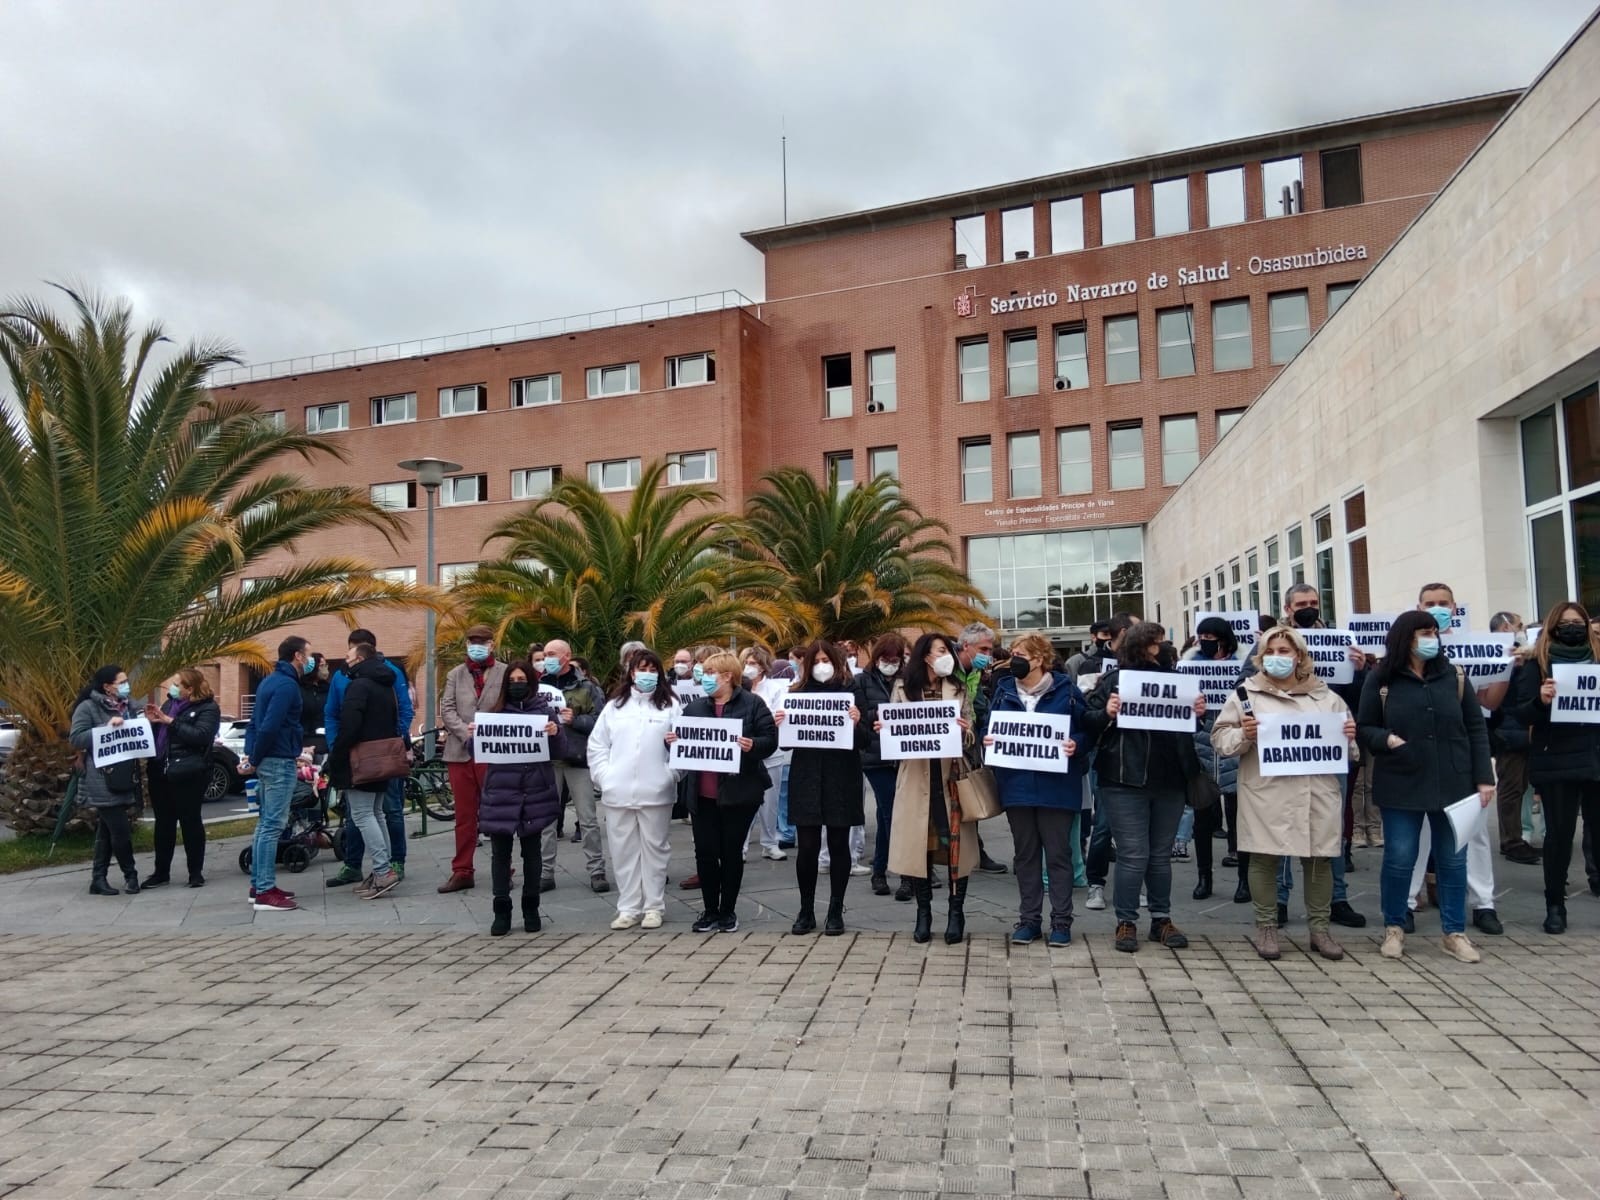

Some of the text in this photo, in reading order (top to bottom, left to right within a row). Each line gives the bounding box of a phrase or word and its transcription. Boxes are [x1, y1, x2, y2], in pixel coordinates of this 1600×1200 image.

[990, 243, 1368, 315] Servicio Navarro de Salud Osasunbidea
[1087, 500, 1095, 508] de
[1348, 621, 1391, 632] AUMENTO
[1307, 650, 1345, 662] ORALES
[1442, 644, 1503, 659] ESTAMOS
[1464, 663, 1508, 677] TADXS
[1200, 680, 1236, 690] ORALES
[1577, 675, 1597, 690] NO
[1140, 682, 1178, 699] NO AL
[783, 698, 851, 711] CONDICIONES
[1120, 701, 1192, 720] ABANDONO
[789, 713, 845, 727] LABORALES
[882, 706, 956, 720] CONDICIONES
[476, 724, 544, 738] AUMENTO DE
[675, 726, 738, 743] AUMENTO DE
[797, 729, 836, 742] DIGNAS
[890, 722, 950, 737] LABORALES
[991, 721, 1065, 740] AUMENTO DE
[1281, 724, 1322, 740] NO AL
[98, 739, 149, 759] AGOTADXS
[481, 741, 541, 754] PLANTILLA
[677, 745, 734, 761] PLANTILLA
[900, 739, 942, 753] DIGNAS
[993, 740, 1060, 760] PLANTILLA
[1263, 745, 1343, 763] ABANDONO
